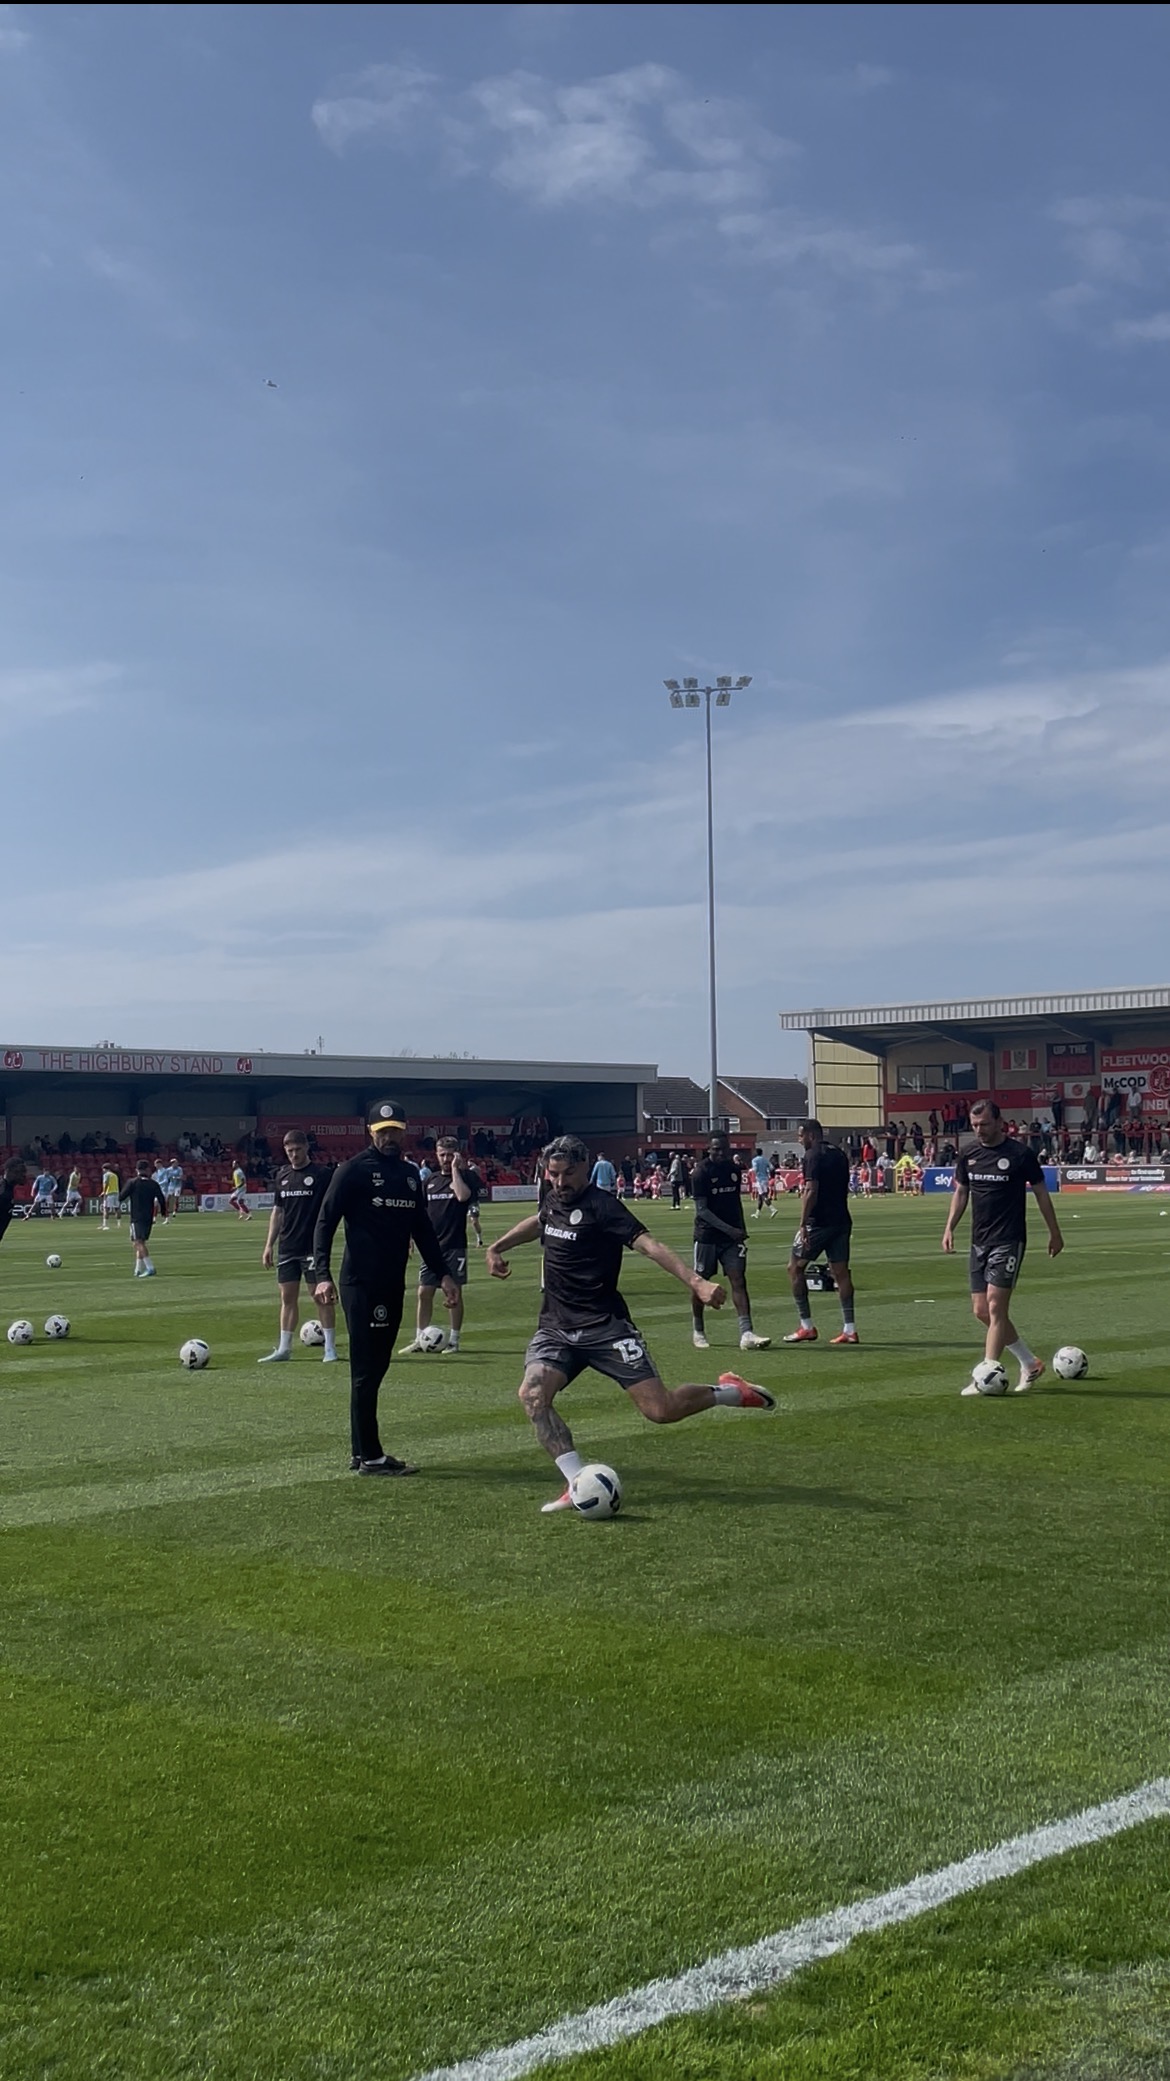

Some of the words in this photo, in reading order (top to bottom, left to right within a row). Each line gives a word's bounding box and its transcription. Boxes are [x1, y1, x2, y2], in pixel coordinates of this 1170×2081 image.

[1053, 1045, 1066, 1055] UP
[1069, 1044, 1087, 1055] THE
[39, 1053, 73, 1070] THE
[79, 1055, 165, 1072] HIGHBURY
[170, 1057, 223, 1073] STAND
[935, 1173, 953, 1187] sky
[974, 1173, 1010, 1182] SUZUKI
[457, 1257, 466, 1272] 7
[1005, 1256, 1016, 1272] 8
[612, 1338, 643, 1364] 13
